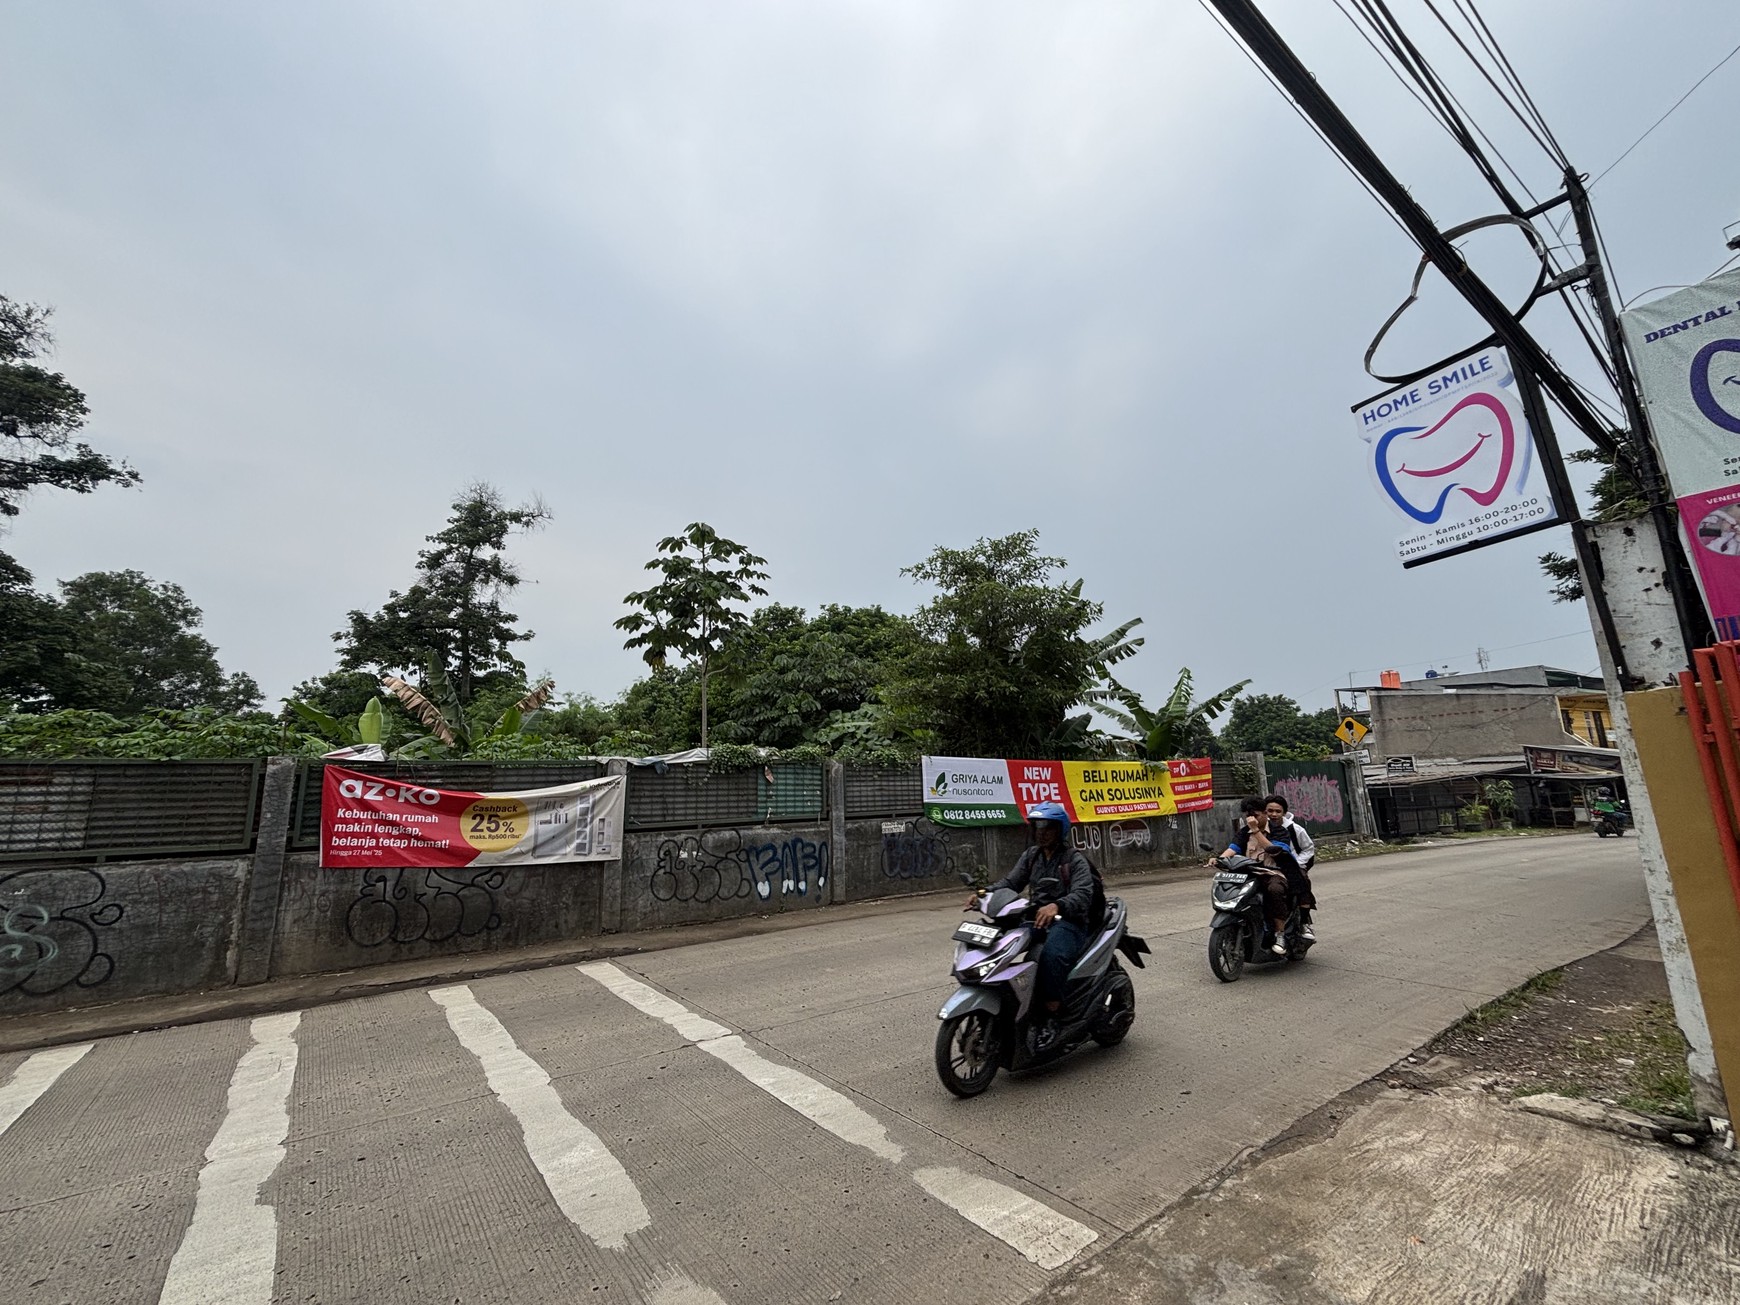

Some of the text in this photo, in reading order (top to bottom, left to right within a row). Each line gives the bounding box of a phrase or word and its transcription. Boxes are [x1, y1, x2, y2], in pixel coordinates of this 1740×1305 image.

[1644, 305, 1732, 344] DENTAL
[1362, 388, 1422, 425] HOME
[1427, 355, 1493, 395] SMILE
[1723, 457, 1740, 465] Se
[1399, 534, 1426, 547] Senin
[1435, 522, 1466, 536] Kamis
[1468, 497, 1538, 525] 16:00-20:00
[1399, 544, 1427, 557] Sabtu
[1436, 529, 1474, 546] Minggu
[1476, 507, 1545, 534] 10:00-17:00
[951, 774, 1004, 784] GRIYA ALAM
[1024, 766, 1052, 780] NEW
[1082, 770, 1108, 783] BELI
[1110, 768, 1148, 782] RUMAH
[952, 788, 994, 796] nusantara
[1018, 782, 1062, 800] TYPE
[1080, 786, 1164, 802] GAN SOLUSINYA
[472, 804, 518, 812] Cashback
[944, 810, 1006, 820] 0812 8459 6653
[1096, 806, 1118, 814] SURVEY
[1118, 804, 1134, 812] DULU
[337, 808, 438, 823] Kebutuhan rumah
[334, 822, 422, 836] makin lengkap,
[332, 836, 450, 848] belanja tetap hemat!
